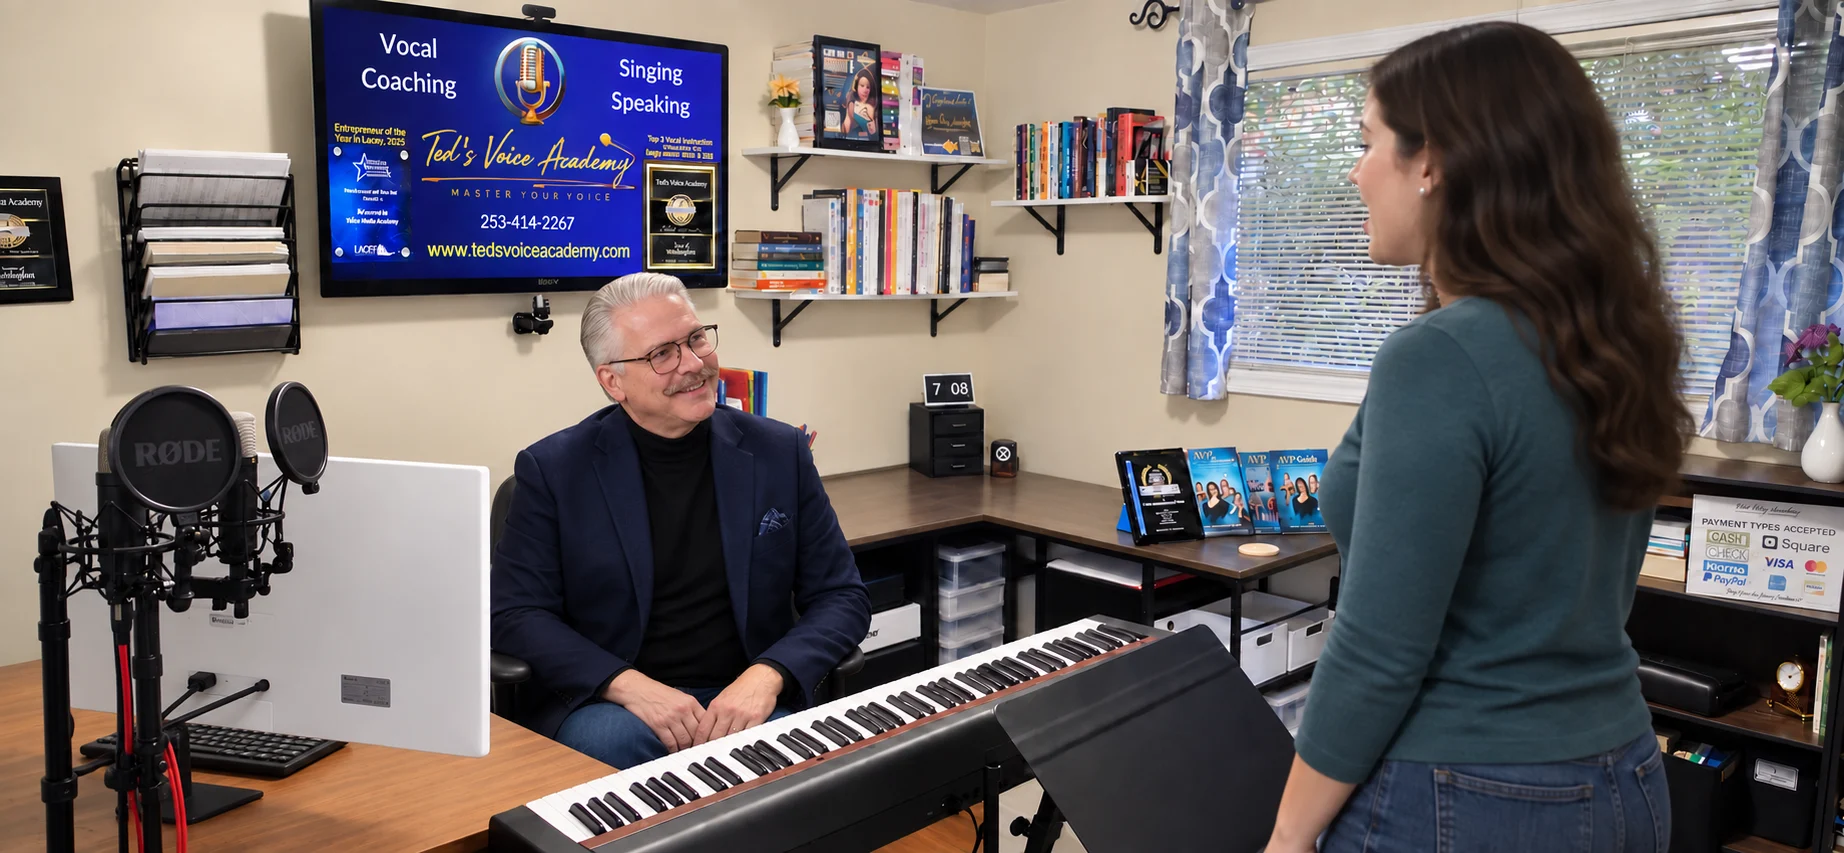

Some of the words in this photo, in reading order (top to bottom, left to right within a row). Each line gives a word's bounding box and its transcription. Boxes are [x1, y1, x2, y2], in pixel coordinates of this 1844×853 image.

[379, 32, 437, 59] Vocal
[619, 58, 683, 86] Singing
[361, 67, 457, 99] Coaching
[611, 91, 691, 119] Speaking
[334, 122, 384, 135] Entrepreneur
[384, 127, 393, 136] of
[393, 127, 407, 137] the
[334, 133, 353, 143] Year
[421, 129, 477, 167] Ted's
[484, 128, 534, 169] Voice
[537, 136, 631, 189] Academy
[451, 188, 512, 199] MASTER
[521, 190, 560, 200] YOUR
[8, 197, 43, 208] Academy
[480, 213, 576, 231] 253-414-2267
[427, 241, 631, 262] www.tedsvoiceacademy.com
[932, 382, 941, 396] 7
[950, 381, 969, 396] 08
[281, 420, 319, 445] RØDE
[134, 438, 222, 468] RØDE
[1193, 450, 1213, 461] AVP
[1248, 454, 1267, 464] AVP
[1278, 455, 1295, 464] AVP
[1701, 517, 1748, 530] PAYMENT
[1750, 521, 1781, 532] TYPES
[1783, 525, 1837, 537] ACCEPTED
[1711, 531, 1743, 545] CASH
[1781, 538, 1831, 554] Square
[1708, 547, 1747, 561] CHECK
[1765, 556, 1795, 570] VISA
[1713, 573, 1748, 587] PayPal
